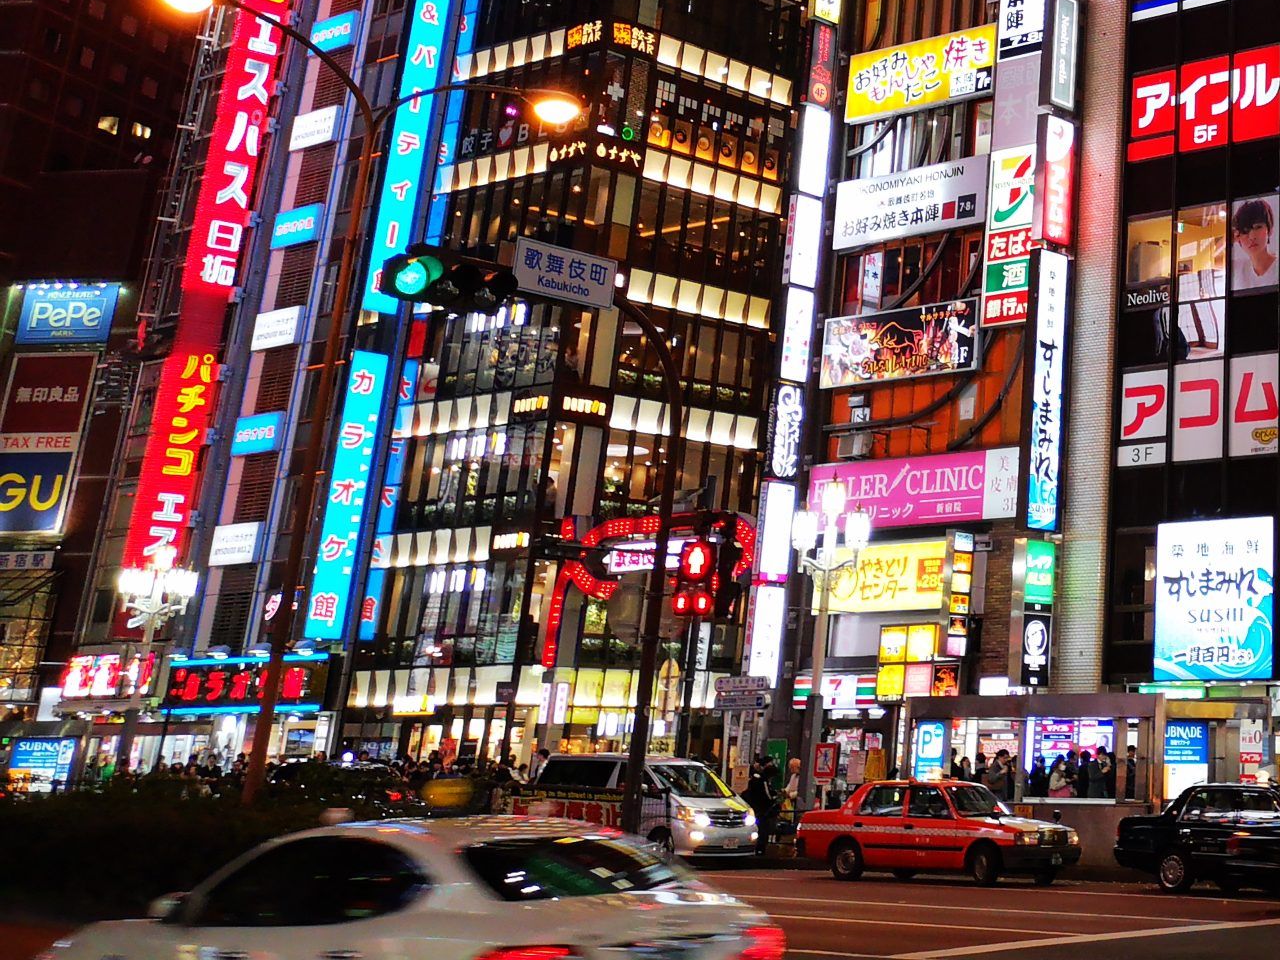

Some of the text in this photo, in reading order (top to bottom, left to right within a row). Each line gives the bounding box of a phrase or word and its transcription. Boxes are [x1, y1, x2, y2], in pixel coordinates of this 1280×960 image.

[631, 38, 655, 54] BAR
[944, 37, 986, 71] 焼き
[856, 52, 907, 90] お好み
[871, 55, 934, 101] もんじゃ
[977, 71, 991, 90] 7F
[905, 69, 940, 102] たこ
[1137, 64, 1280, 128] アイフル
[215, 15, 282, 209] エスパス
[1194, 125, 1217, 144] 5F
[926, 165, 964, 182] HONJIN
[842, 203, 939, 237] お好み焼き本陣
[524, 247, 609, 286] 歌舞伎町
[1002, 263, 1026, 286] 酒
[537, 275, 590, 297] Kabukicho
[1127, 290, 1168, 306] Neolive
[30, 300, 102, 328] PePe
[986, 296, 1028, 319] 銀行AT
[16, 386, 79, 403] 無印良品
[1123, 372, 1279, 437] アコム
[162, 354, 214, 476] パチンコ
[1, 435, 72, 449] TAX FREE
[1132, 447, 1154, 462] 3F
[0, 472, 63, 512] GU
[906, 466, 984, 495] CLINIC
[312, 370, 374, 623] カラオケ館
[859, 556, 907, 577] やきとり
[859, 580, 908, 600] センター
[922, 730, 933, 746] P
